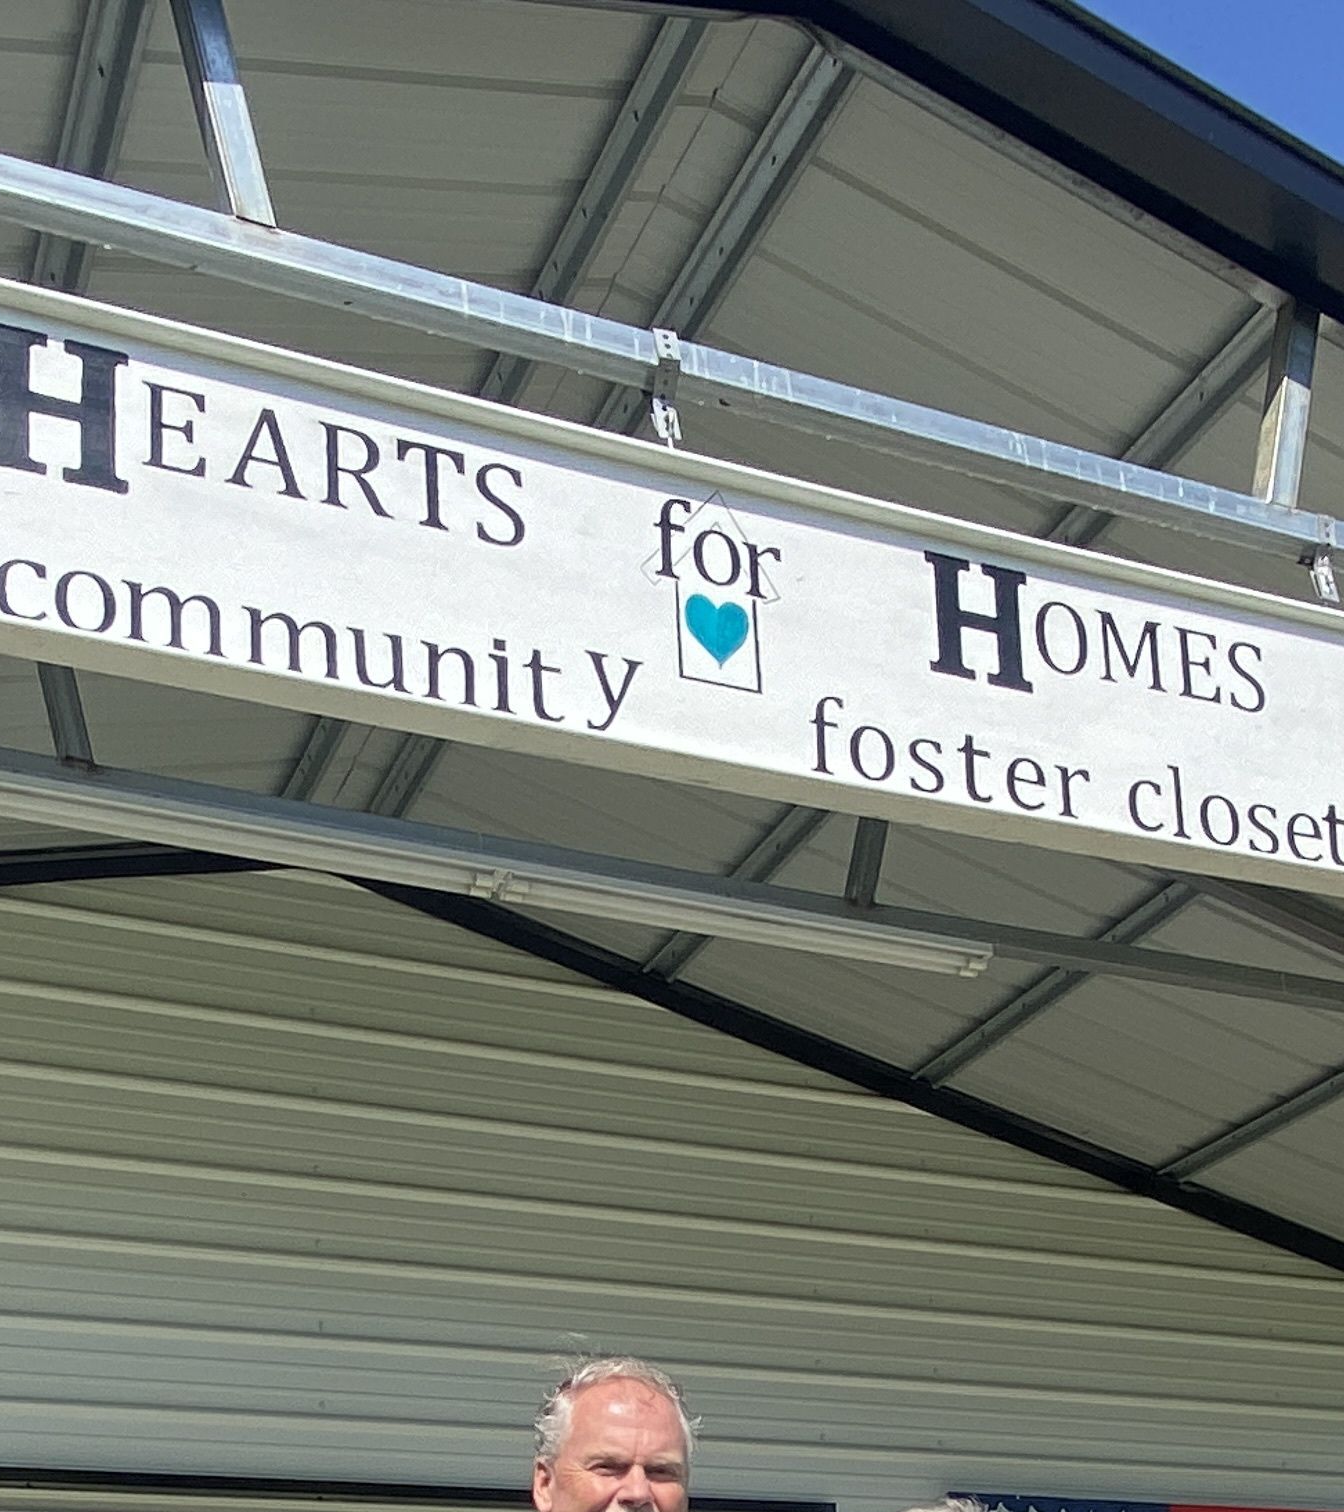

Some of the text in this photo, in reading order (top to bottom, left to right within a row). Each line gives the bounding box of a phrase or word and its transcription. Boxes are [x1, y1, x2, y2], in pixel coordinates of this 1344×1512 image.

[653, 498, 782, 600] for
[923, 550, 1267, 713] HOMES
[811, 696, 1090, 817] foster
